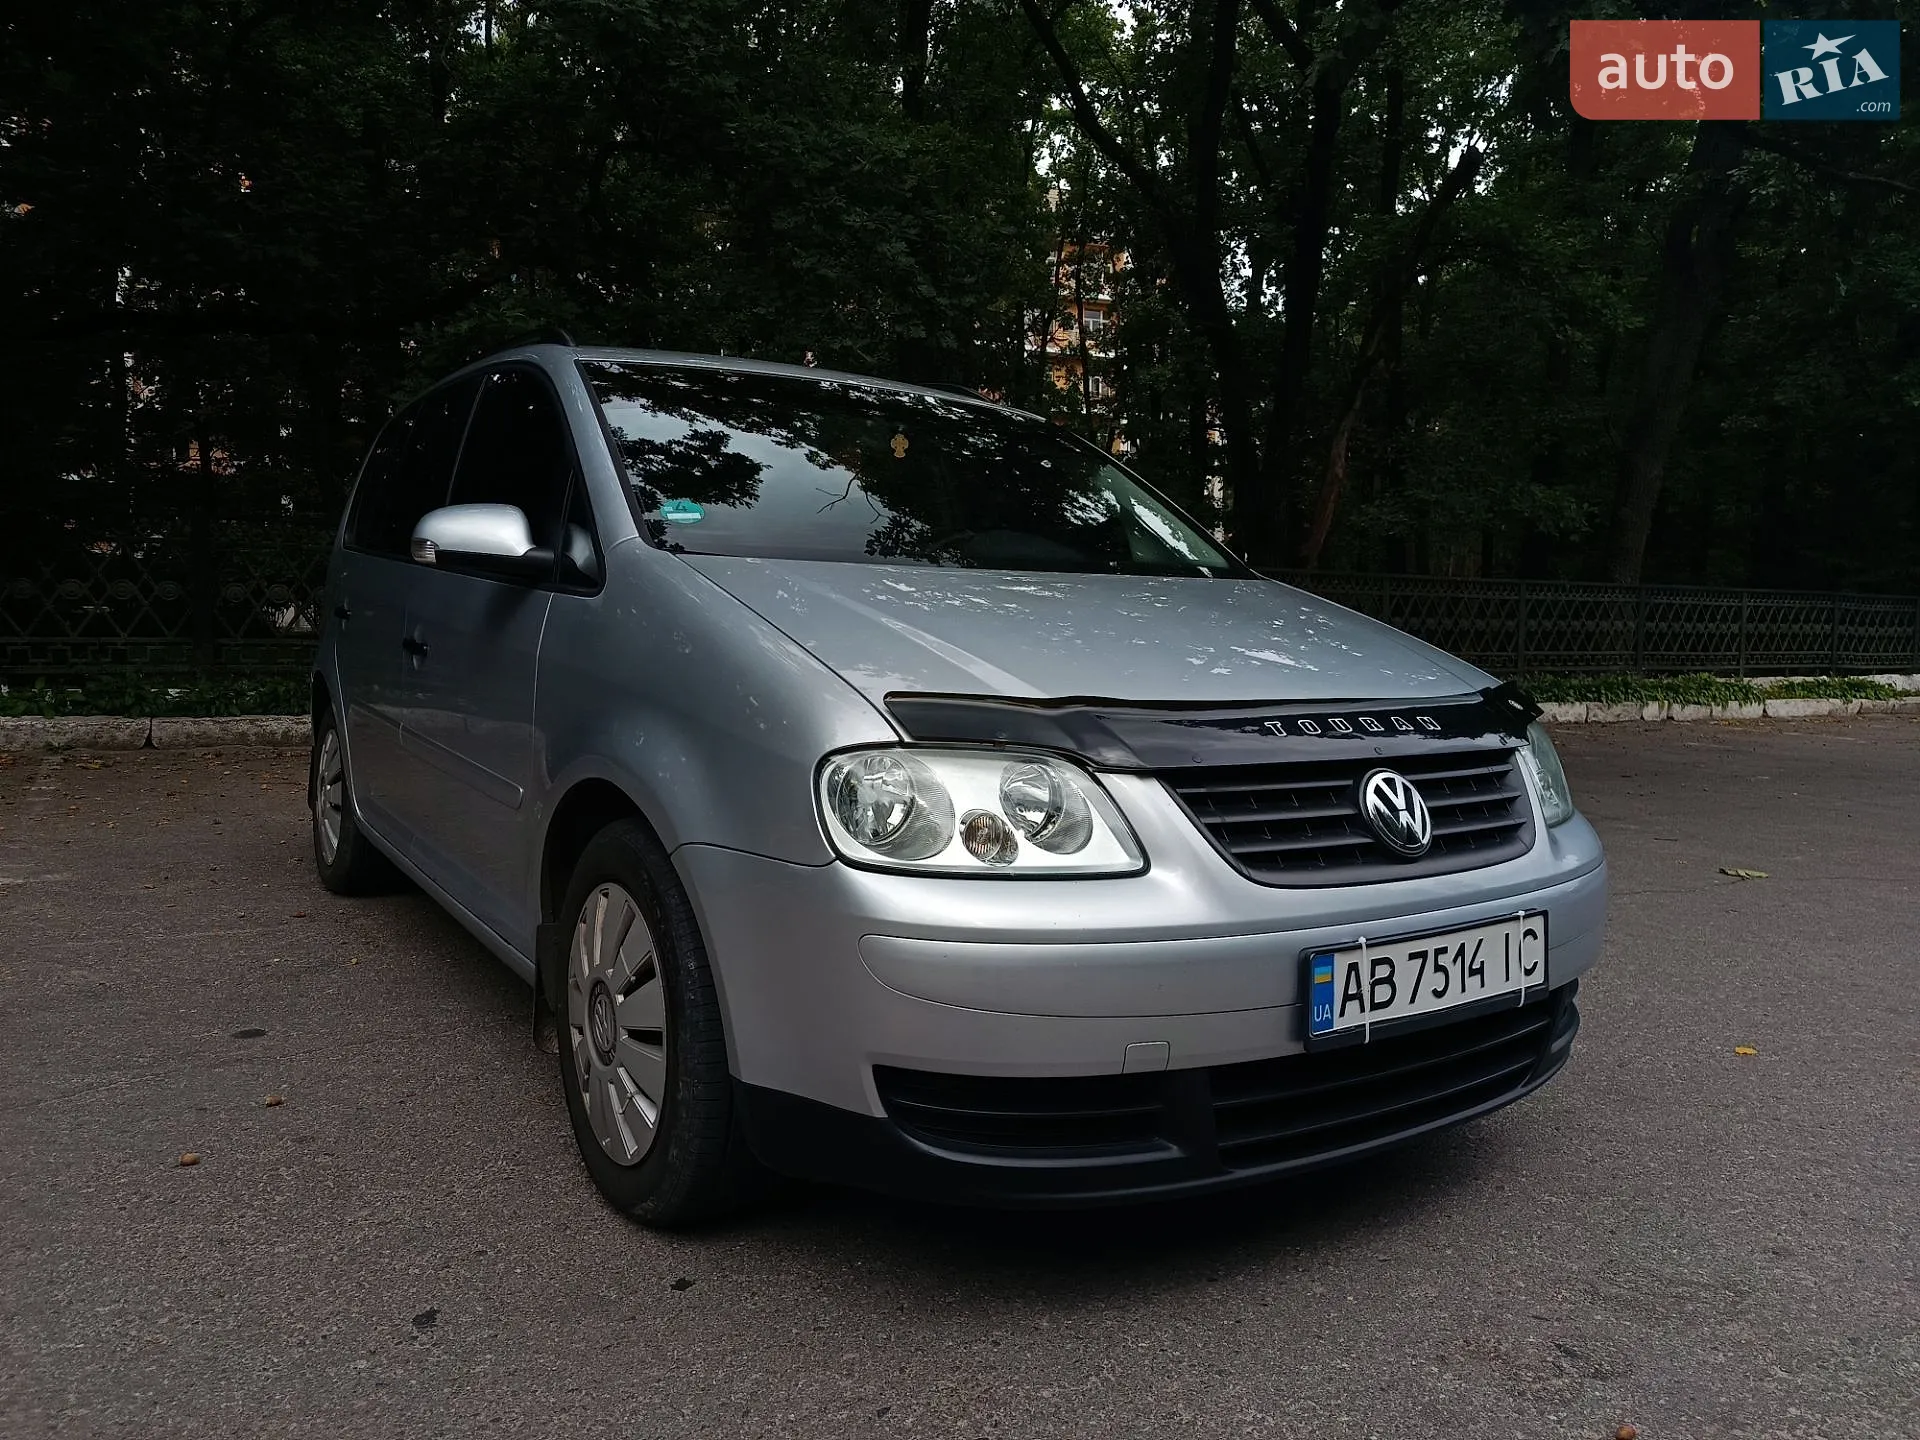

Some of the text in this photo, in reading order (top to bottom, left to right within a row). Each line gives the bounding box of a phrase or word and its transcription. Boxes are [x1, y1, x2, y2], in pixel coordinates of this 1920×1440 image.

[1264, 716, 1441, 737] TOURAN
[1338, 928, 1540, 1018] AB 7514 IC
[1313, 1005, 1332, 1022] UA
